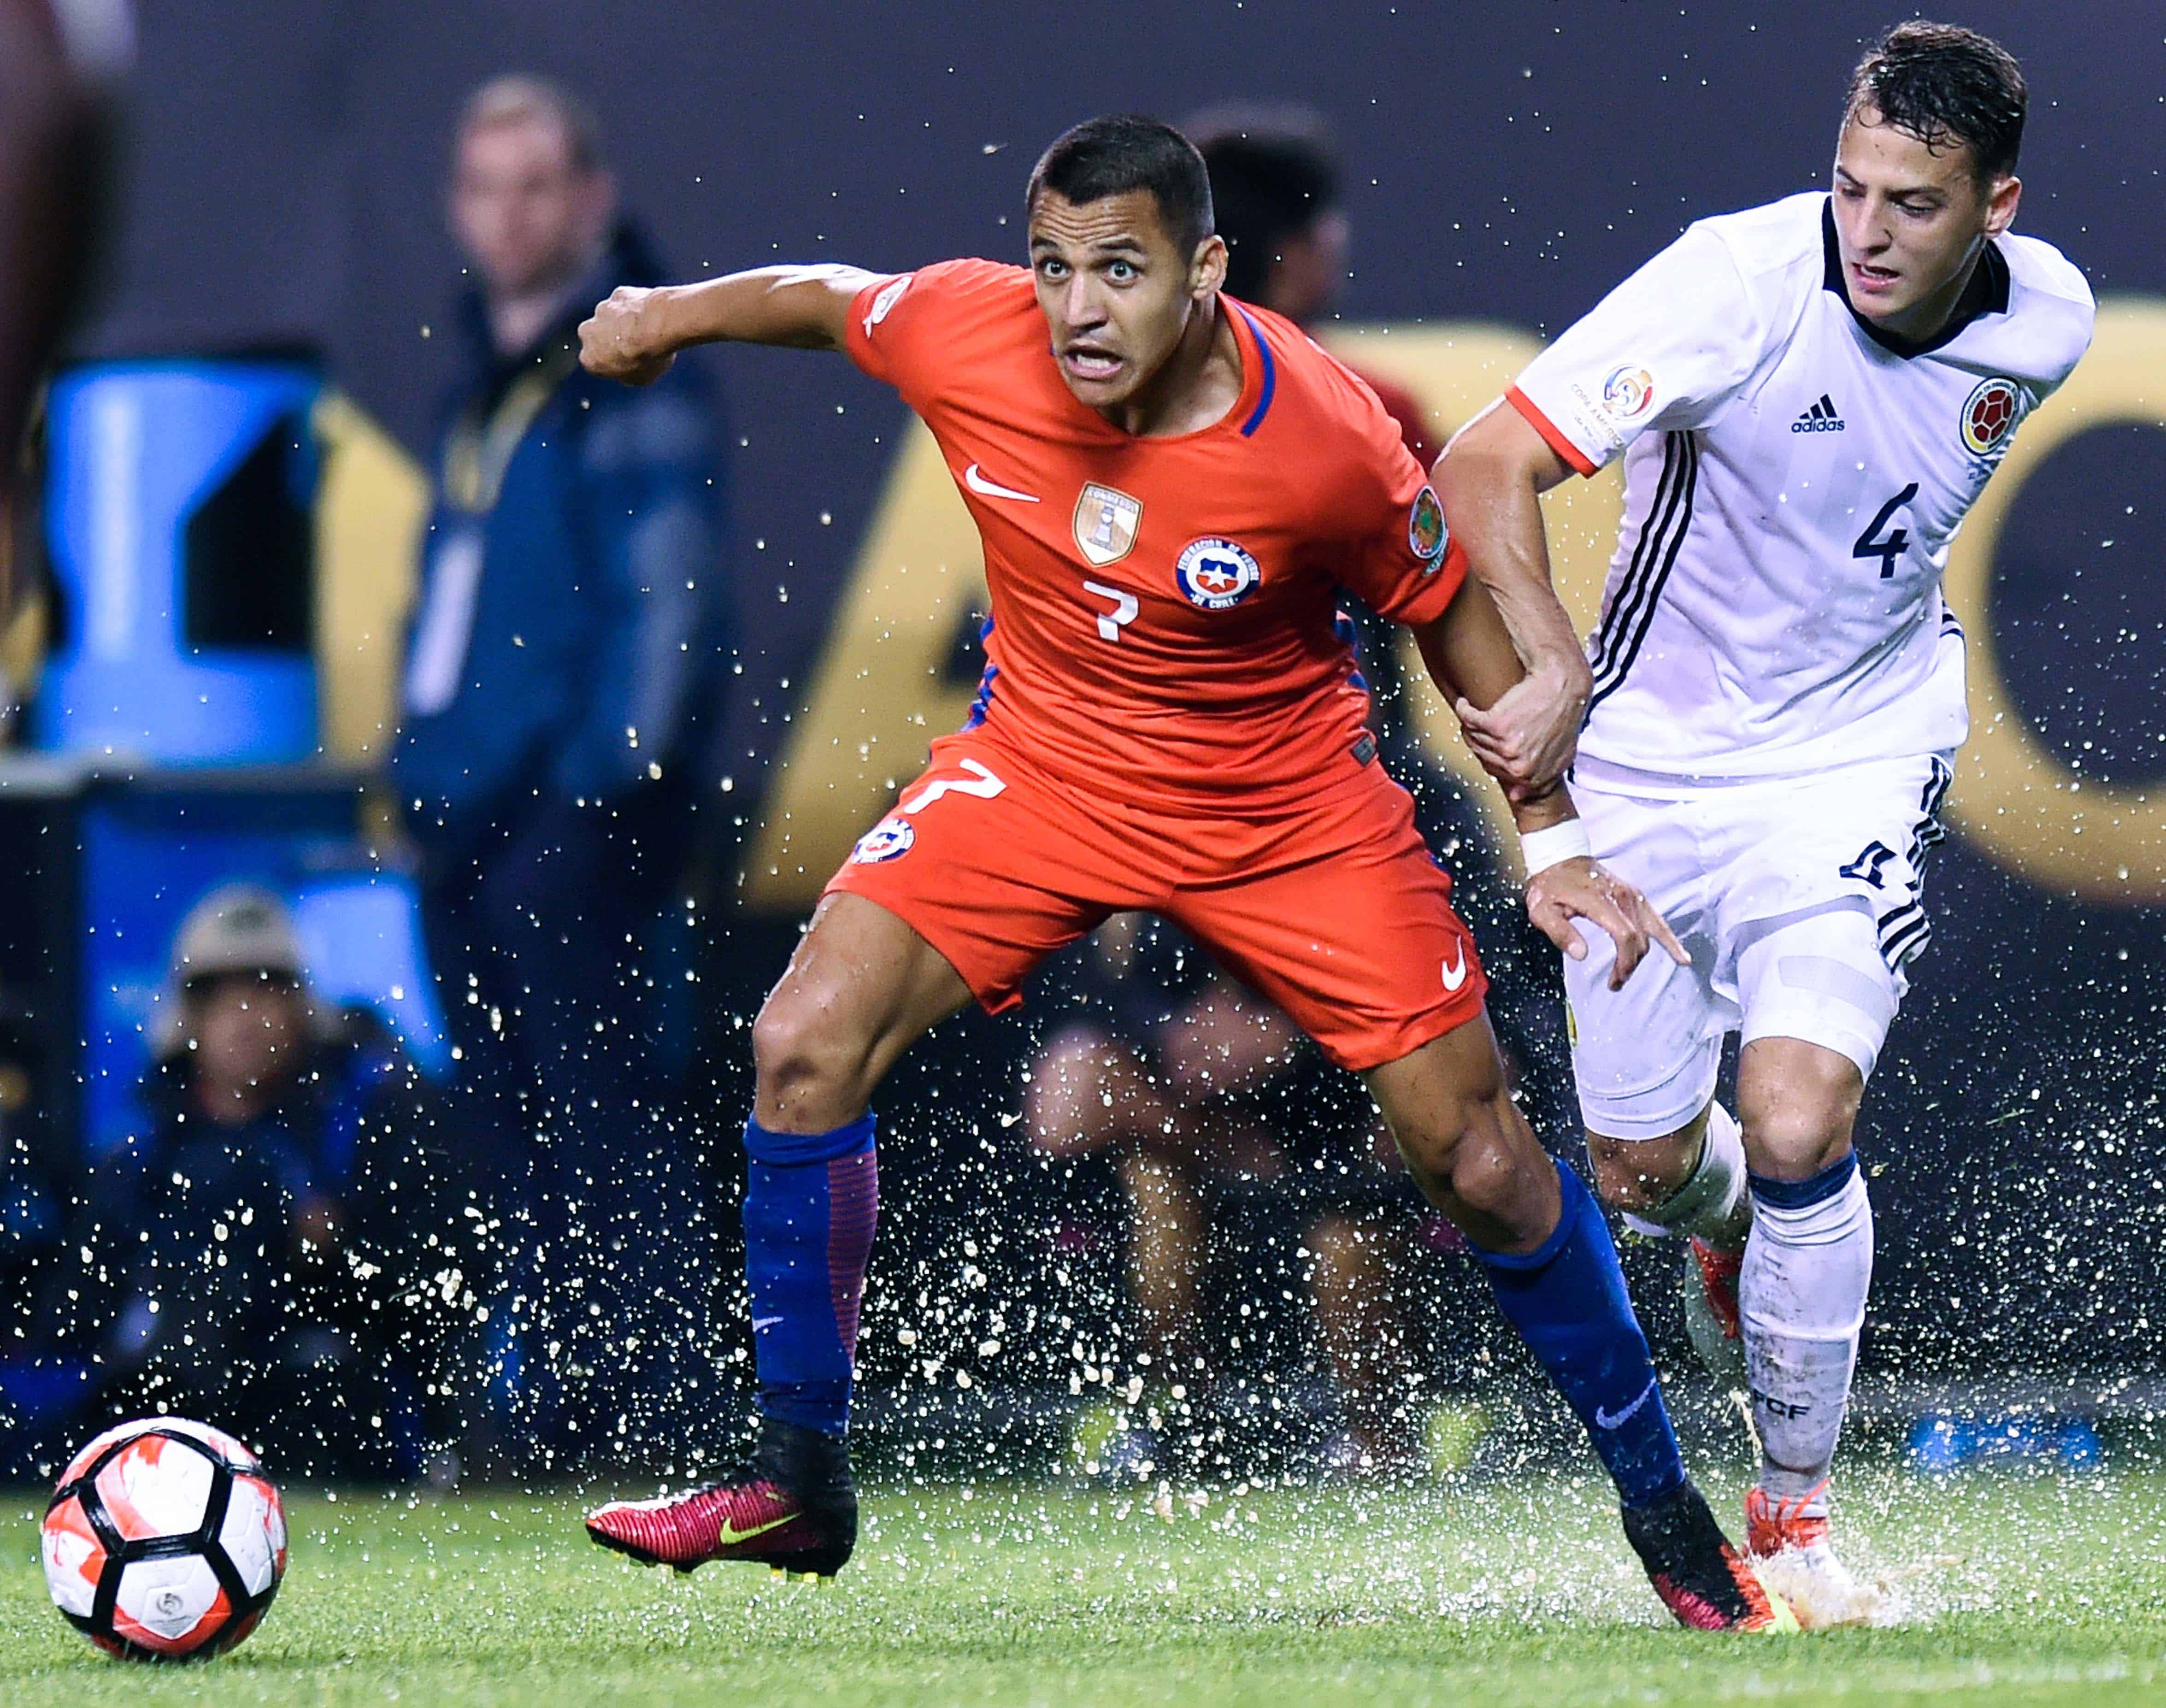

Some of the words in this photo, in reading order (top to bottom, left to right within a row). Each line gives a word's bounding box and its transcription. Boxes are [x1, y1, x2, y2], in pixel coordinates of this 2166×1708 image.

[1791, 419, 1845, 433] adidas
[1852, 483, 1919, 579] 4
[1084, 581, 1138, 641] 7
[904, 758, 1007, 814] 7
